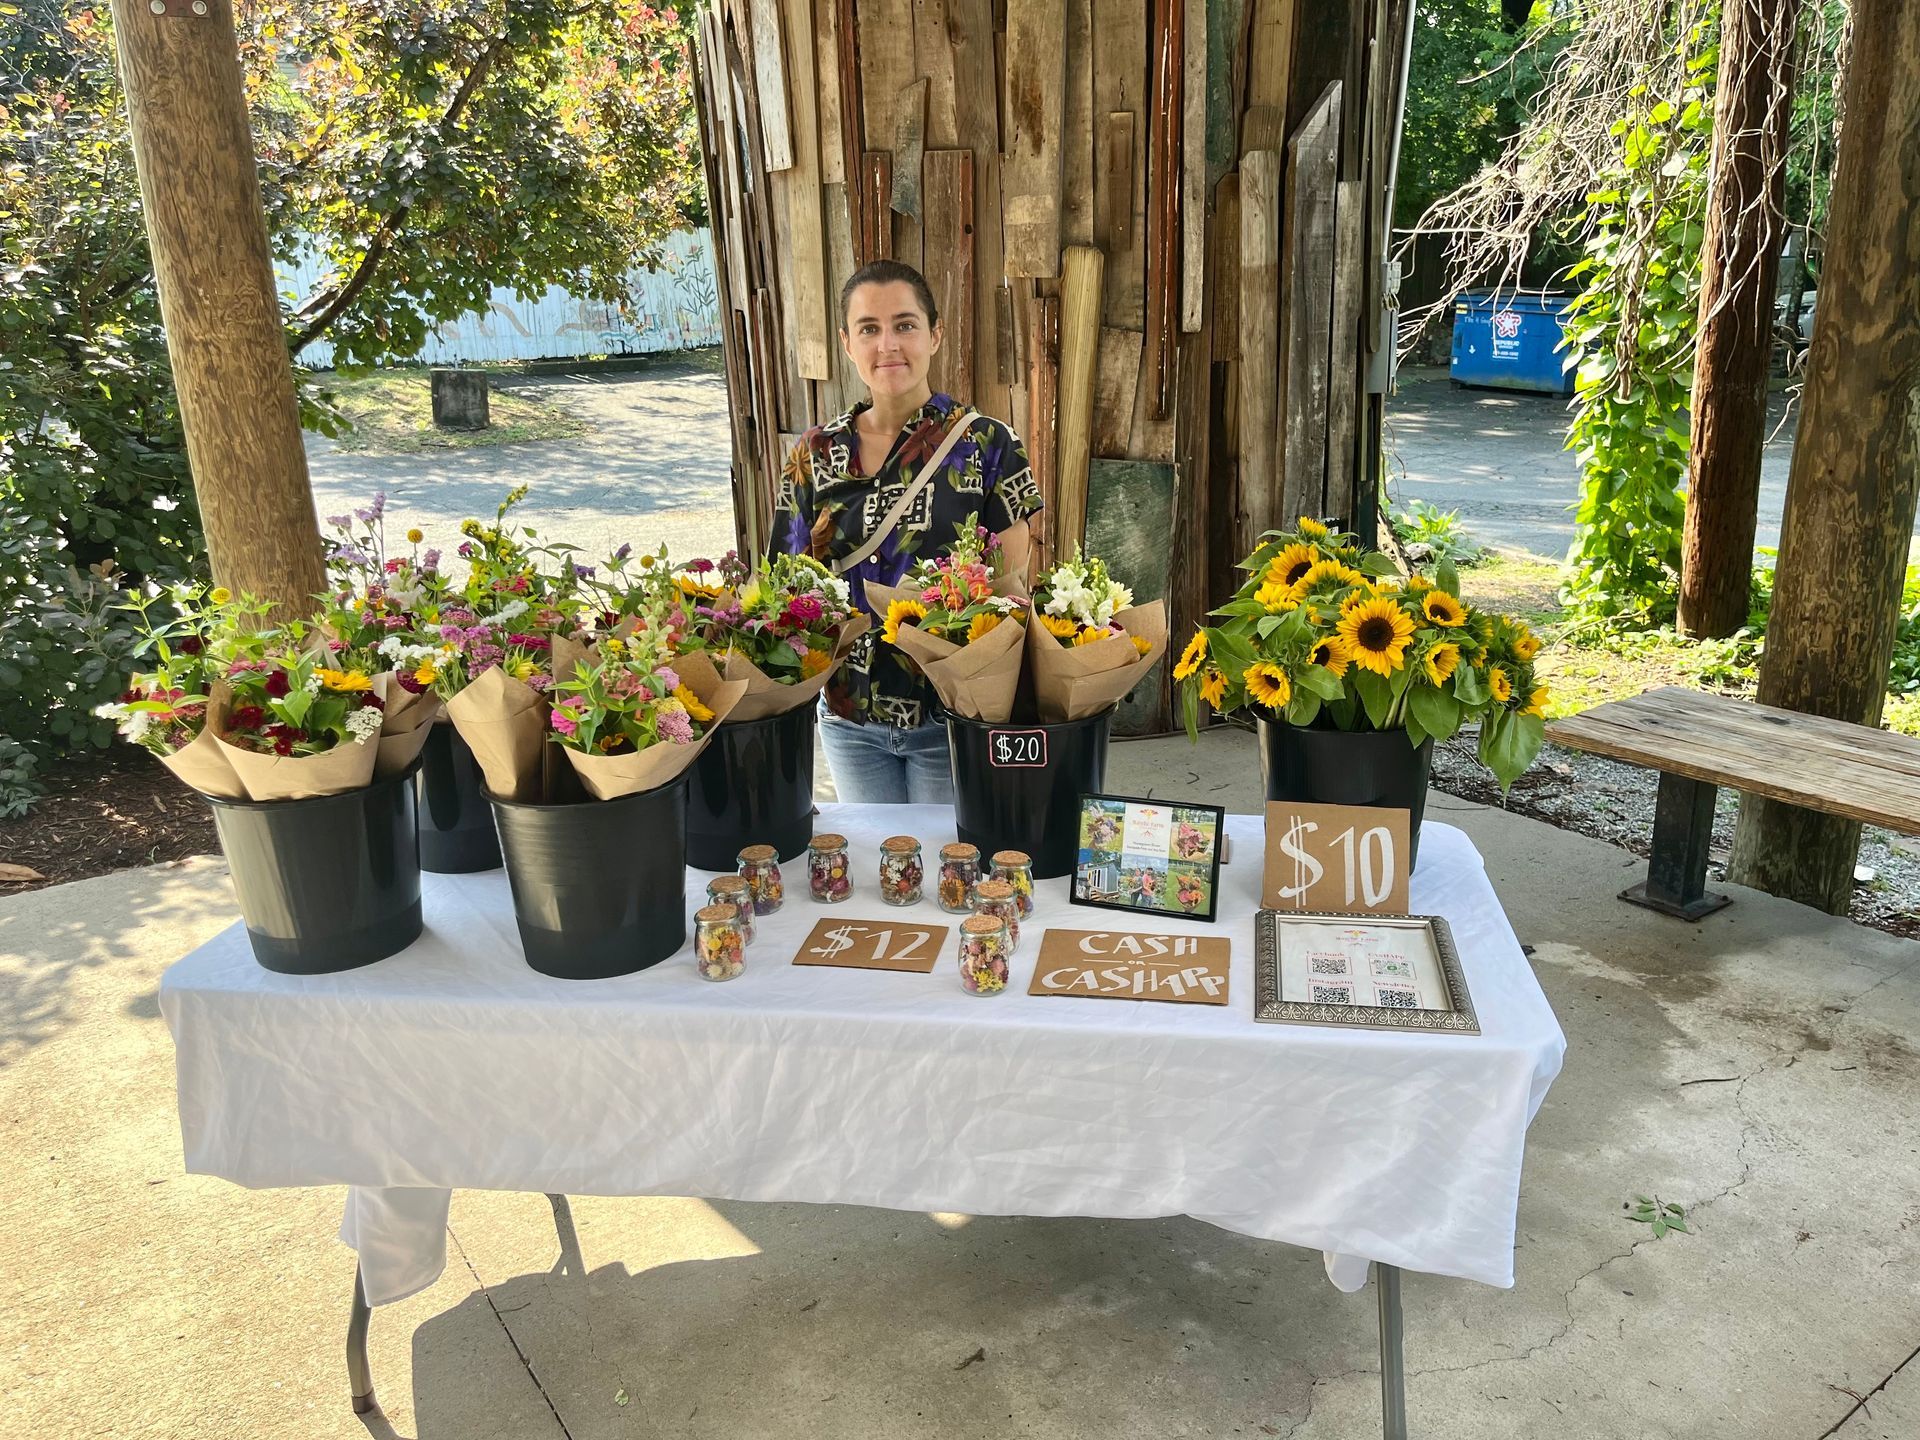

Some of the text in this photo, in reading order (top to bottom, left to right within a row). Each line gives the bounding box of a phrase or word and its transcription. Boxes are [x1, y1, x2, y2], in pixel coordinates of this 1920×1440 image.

[996, 734, 1040, 763] $20
[1277, 815, 1395, 909] $10
[809, 925, 931, 961] $12
[1078, 933, 1198, 959] CASH
[1041, 966, 1226, 997] CASHAPP
